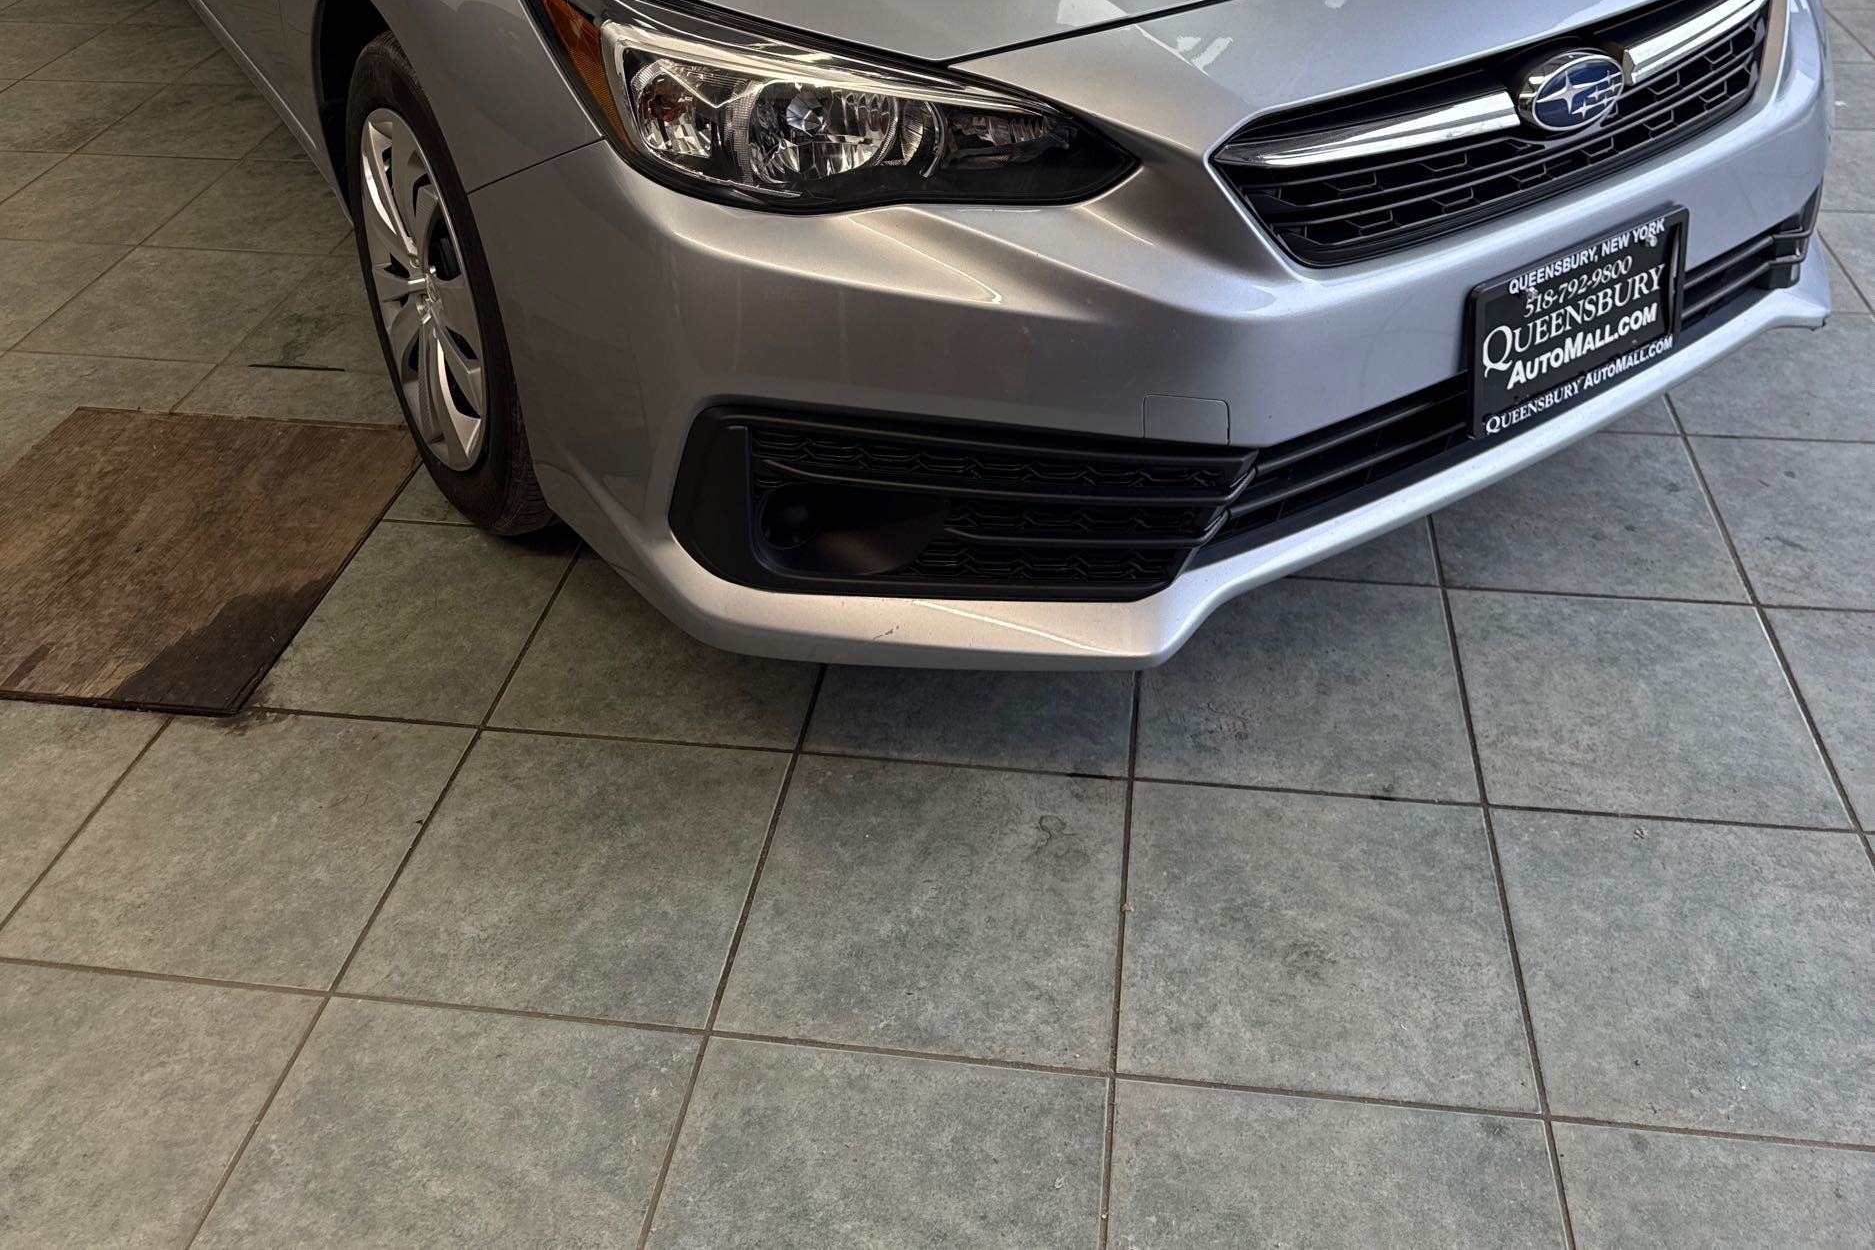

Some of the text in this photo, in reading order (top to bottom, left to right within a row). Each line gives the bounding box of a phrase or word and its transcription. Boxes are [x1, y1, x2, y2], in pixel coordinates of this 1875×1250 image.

[1508, 218, 1666, 295] QUEENSBURY, NEW YORK
[1523, 255, 1634, 319] 518-792-9800
[1482, 264, 1666, 378] QUEENSBURY
[1485, 376, 1584, 436] QUEENSBURY
